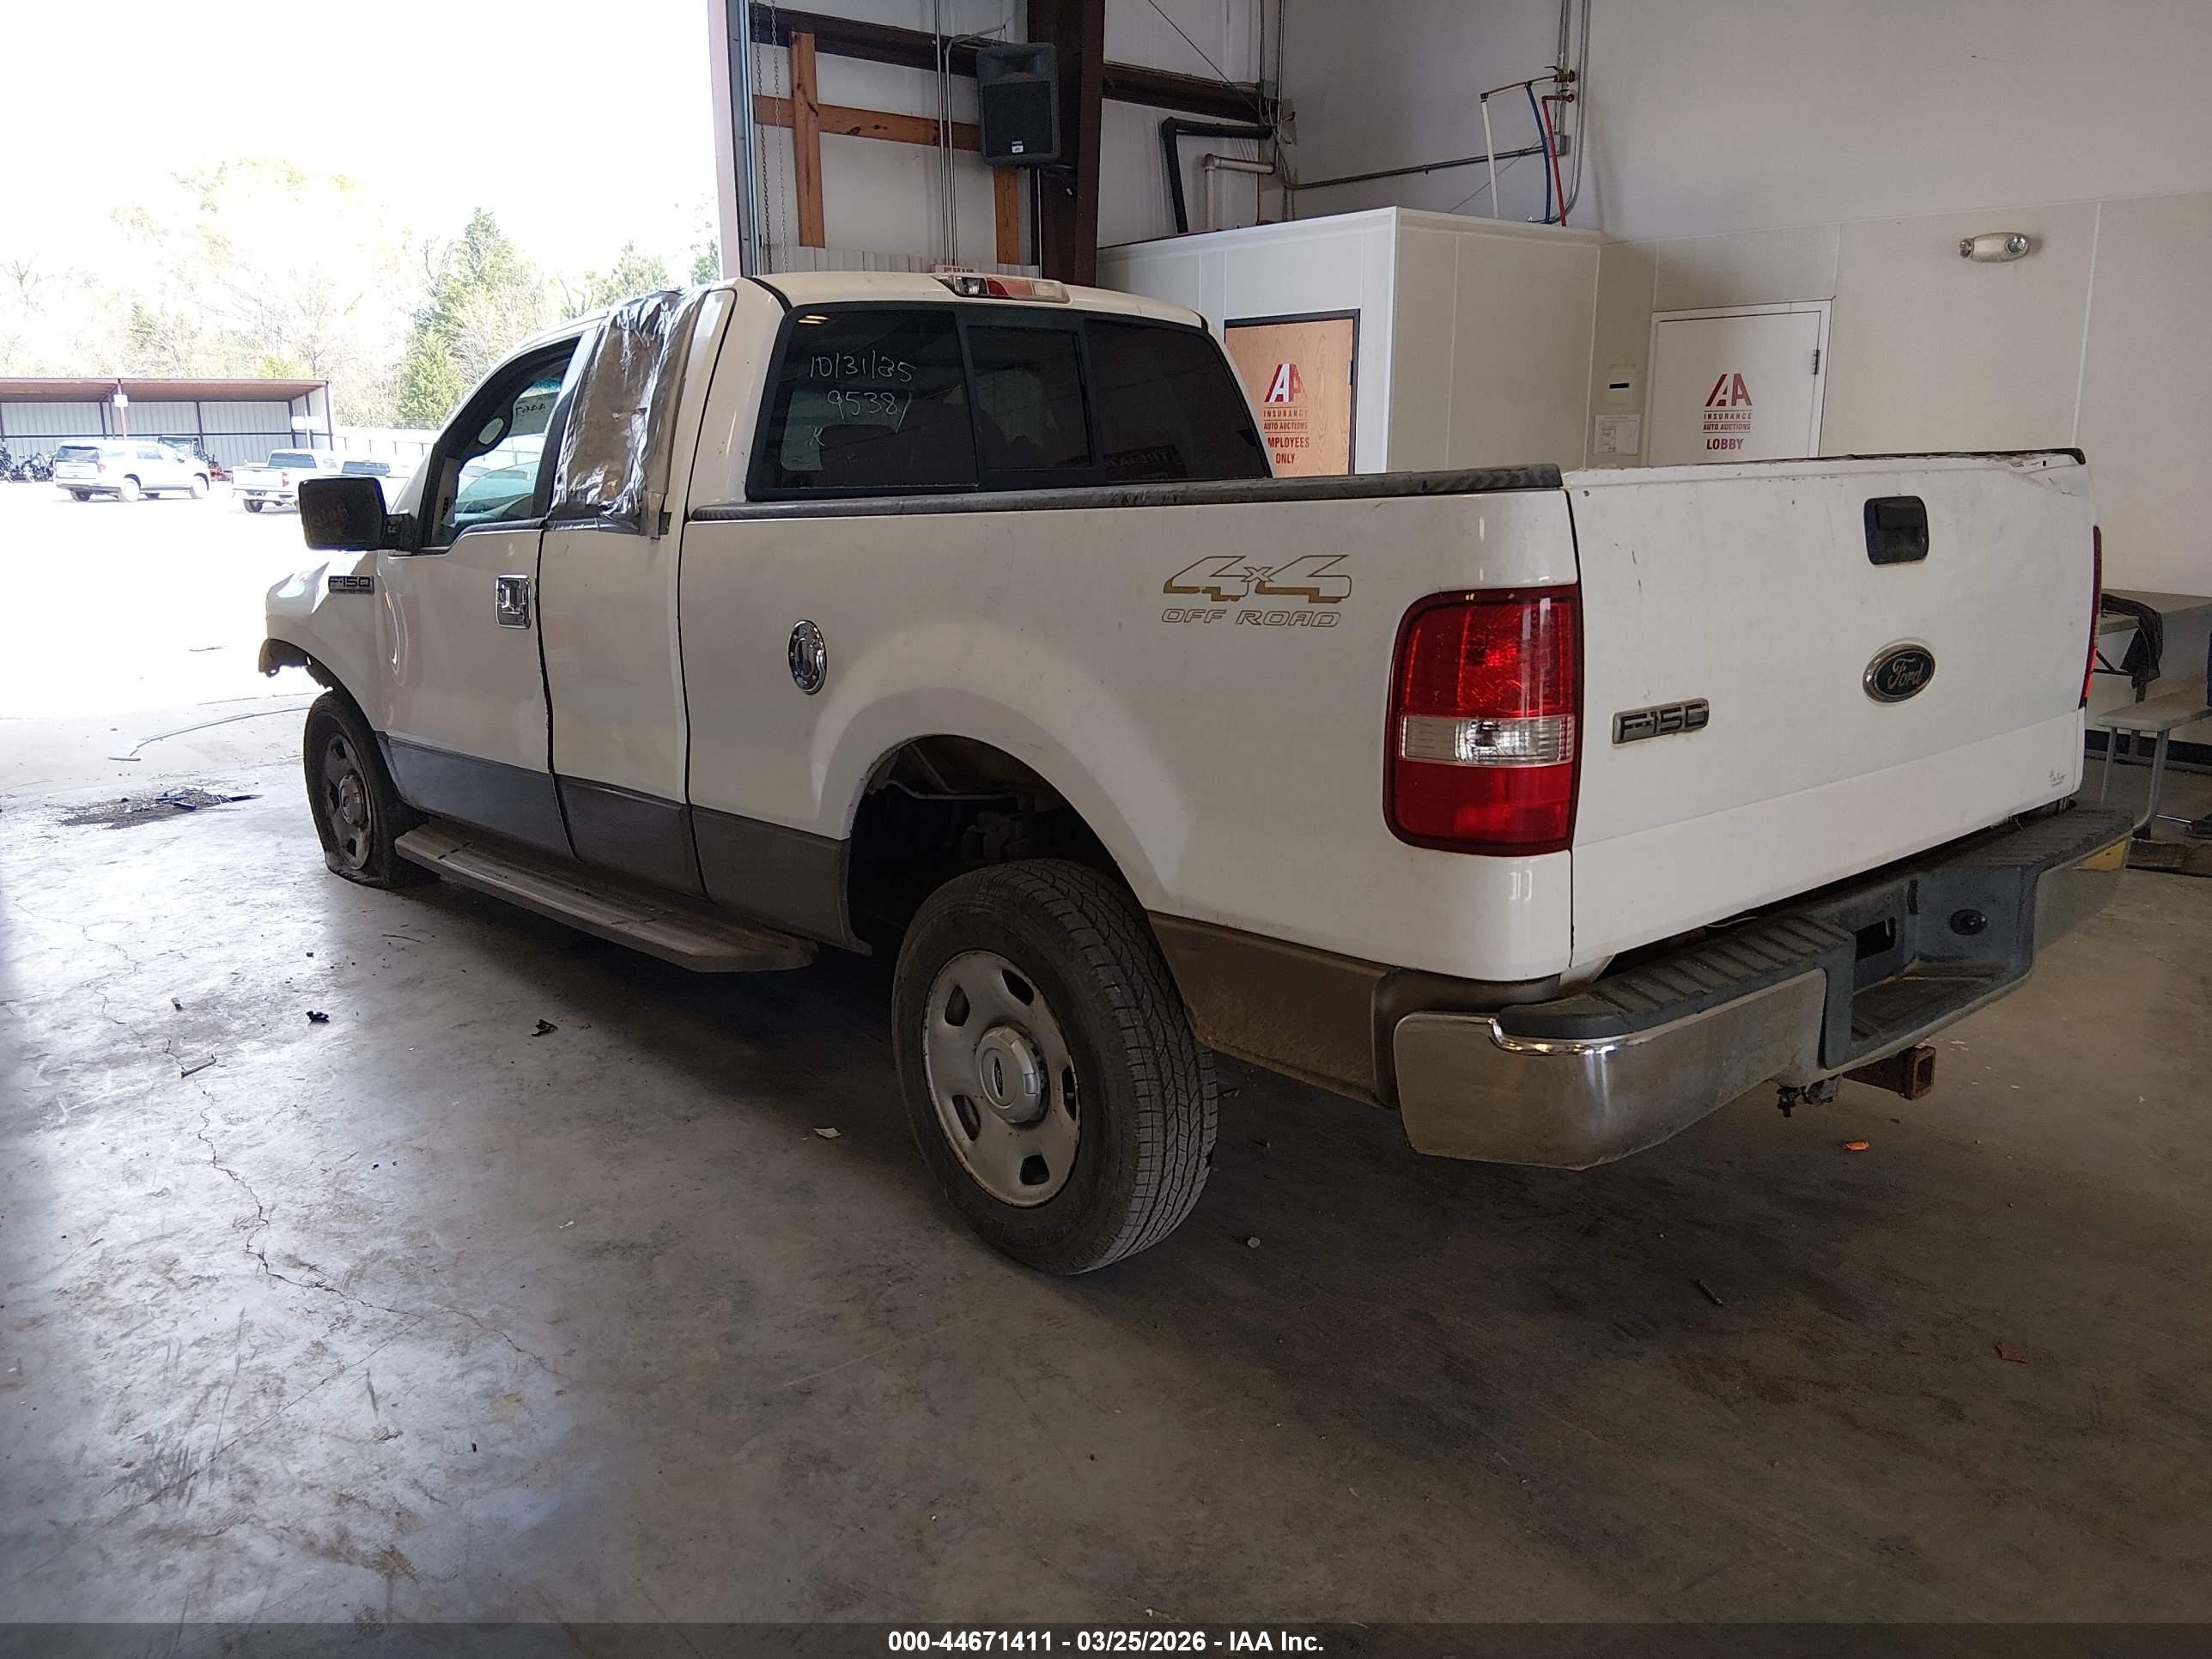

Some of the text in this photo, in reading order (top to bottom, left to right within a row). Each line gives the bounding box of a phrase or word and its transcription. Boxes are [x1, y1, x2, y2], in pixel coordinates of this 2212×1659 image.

[1263, 410, 1308, 418] INSURANCE
[1263, 422, 1308, 430] AUTO AUCTIONS
[1267, 437, 1310, 448] MPLOYEES
[1706, 438, 1744, 450] LOBBY
[1275, 453, 1296, 465] ONLY
[1162, 608, 1342, 628] OFF ROAD
[1887, 658, 1923, 690] Ford
[1620, 702, 1708, 740] F-150
